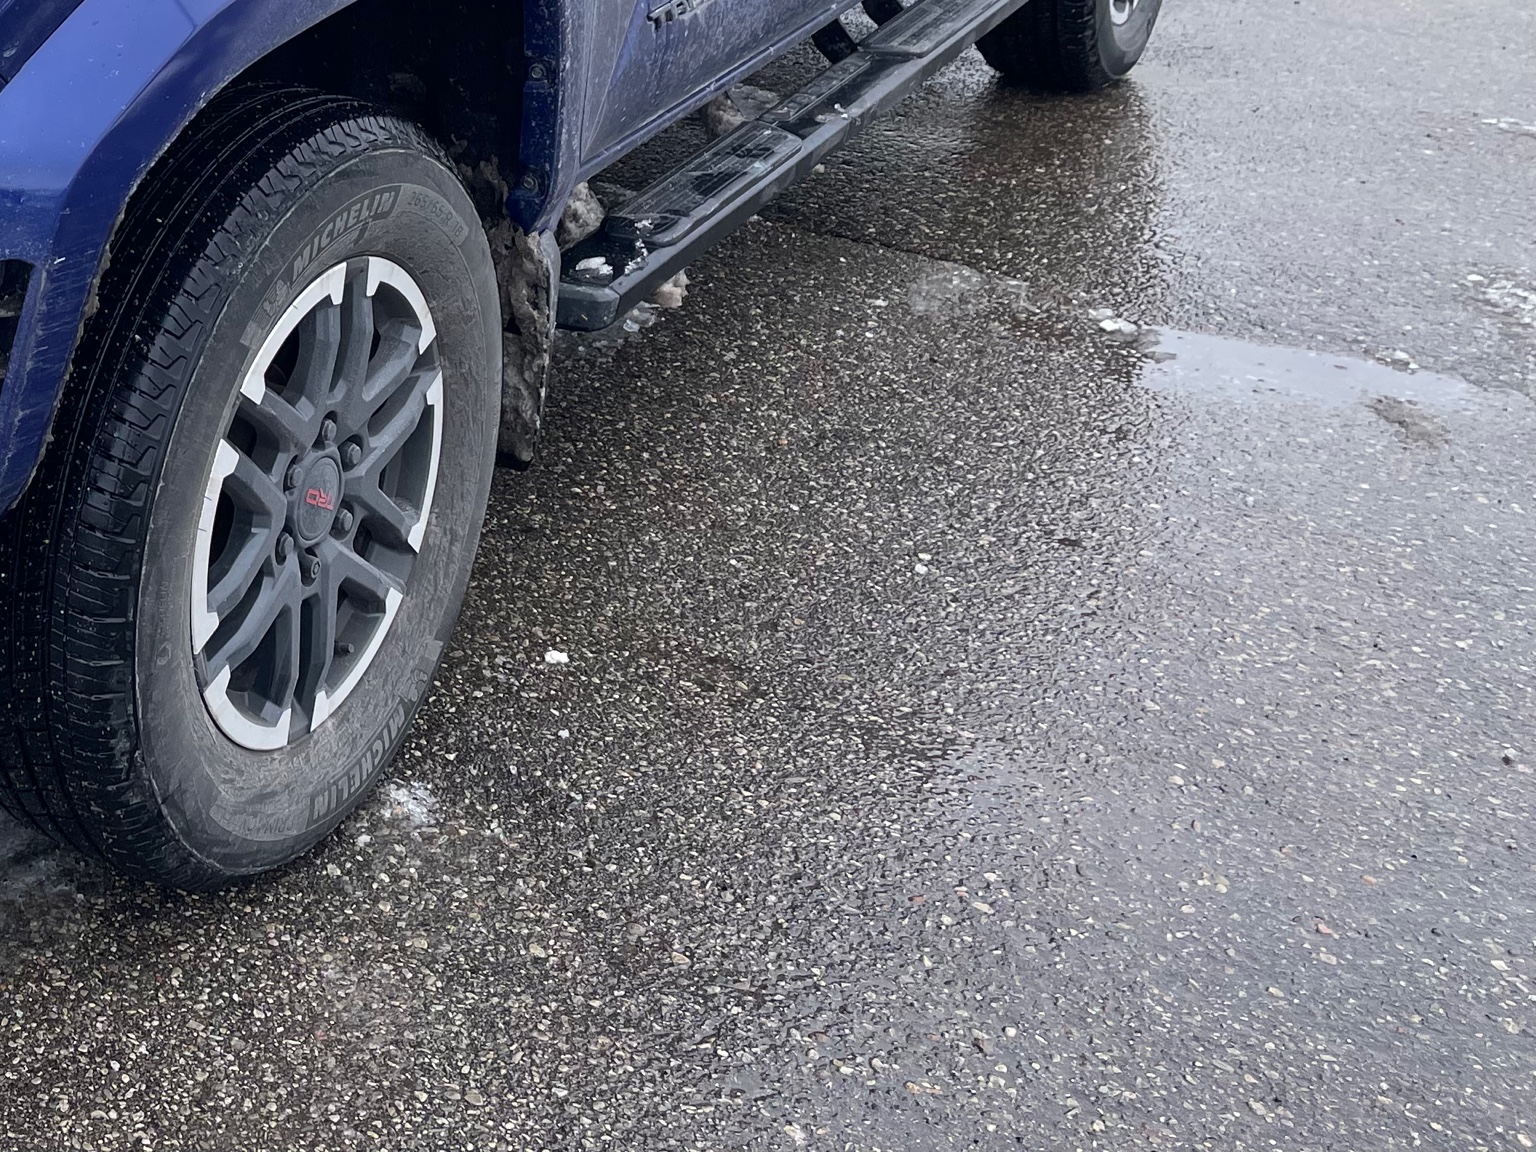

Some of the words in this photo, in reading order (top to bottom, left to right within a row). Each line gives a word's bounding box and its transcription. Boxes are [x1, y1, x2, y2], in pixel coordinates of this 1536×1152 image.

[292, 191, 396, 282] MICHELIN
[305, 488, 334, 511] TRD
[312, 703, 405, 820] MICHELIN
